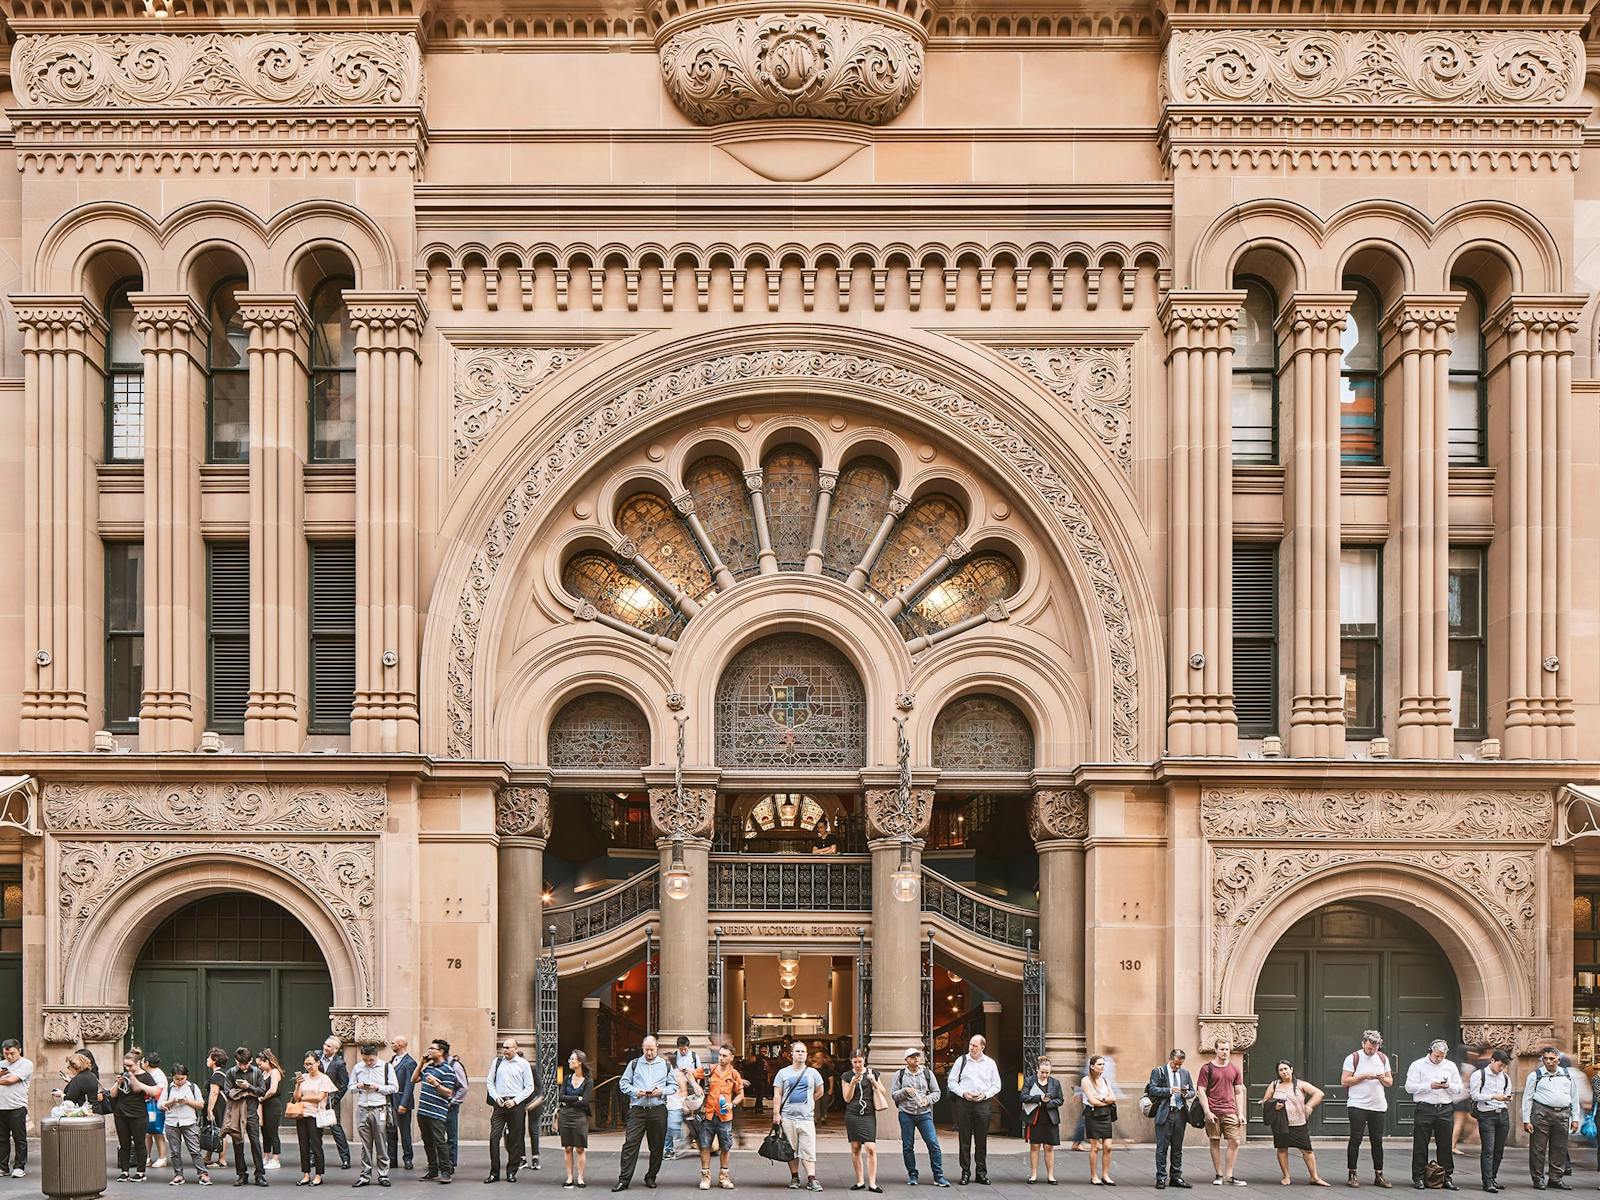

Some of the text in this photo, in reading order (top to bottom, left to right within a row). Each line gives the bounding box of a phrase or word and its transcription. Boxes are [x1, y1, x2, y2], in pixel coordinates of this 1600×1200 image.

[758, 926, 807, 936] VICTORIA
[447, 958, 462, 969] 78
[1119, 959, 1142, 971] 130
